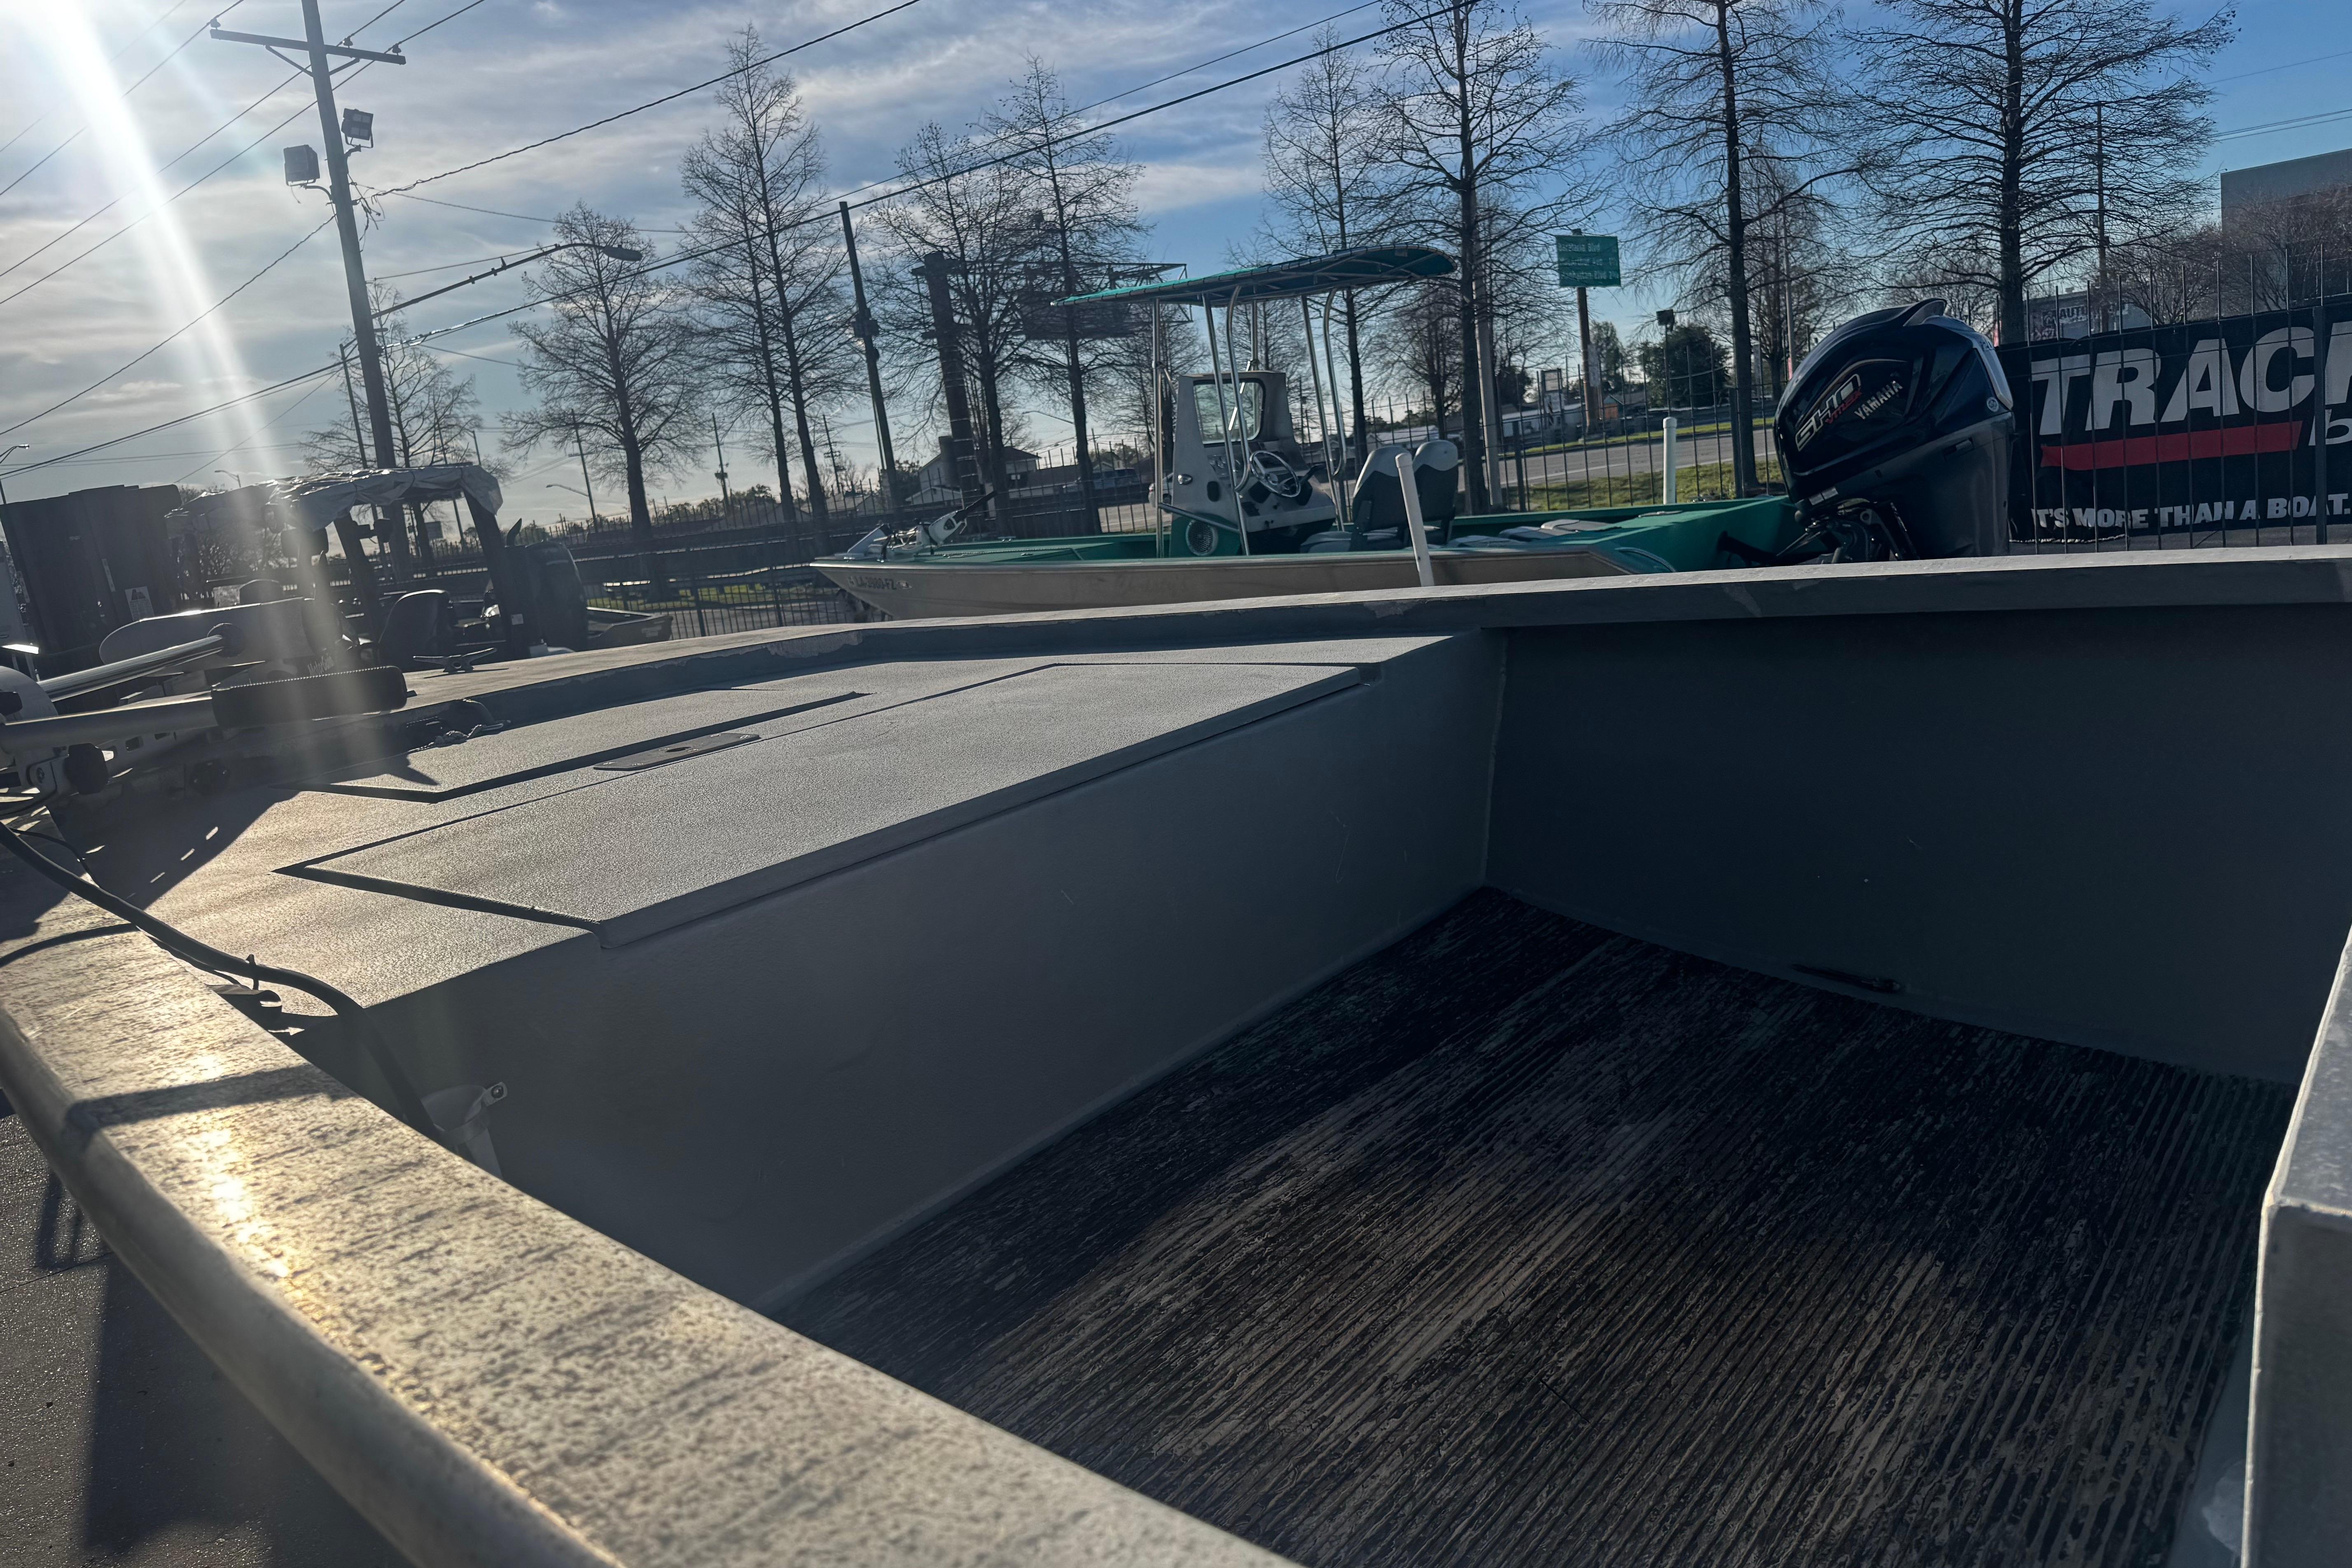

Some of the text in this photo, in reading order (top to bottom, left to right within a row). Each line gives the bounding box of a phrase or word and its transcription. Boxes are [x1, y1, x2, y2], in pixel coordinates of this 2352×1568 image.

[1854, 380, 1903, 420] YAMAHA
[2072, 508, 2148, 529] MORE
[2154, 501, 2234, 527] THAN
[2239, 499, 2260, 520] A
